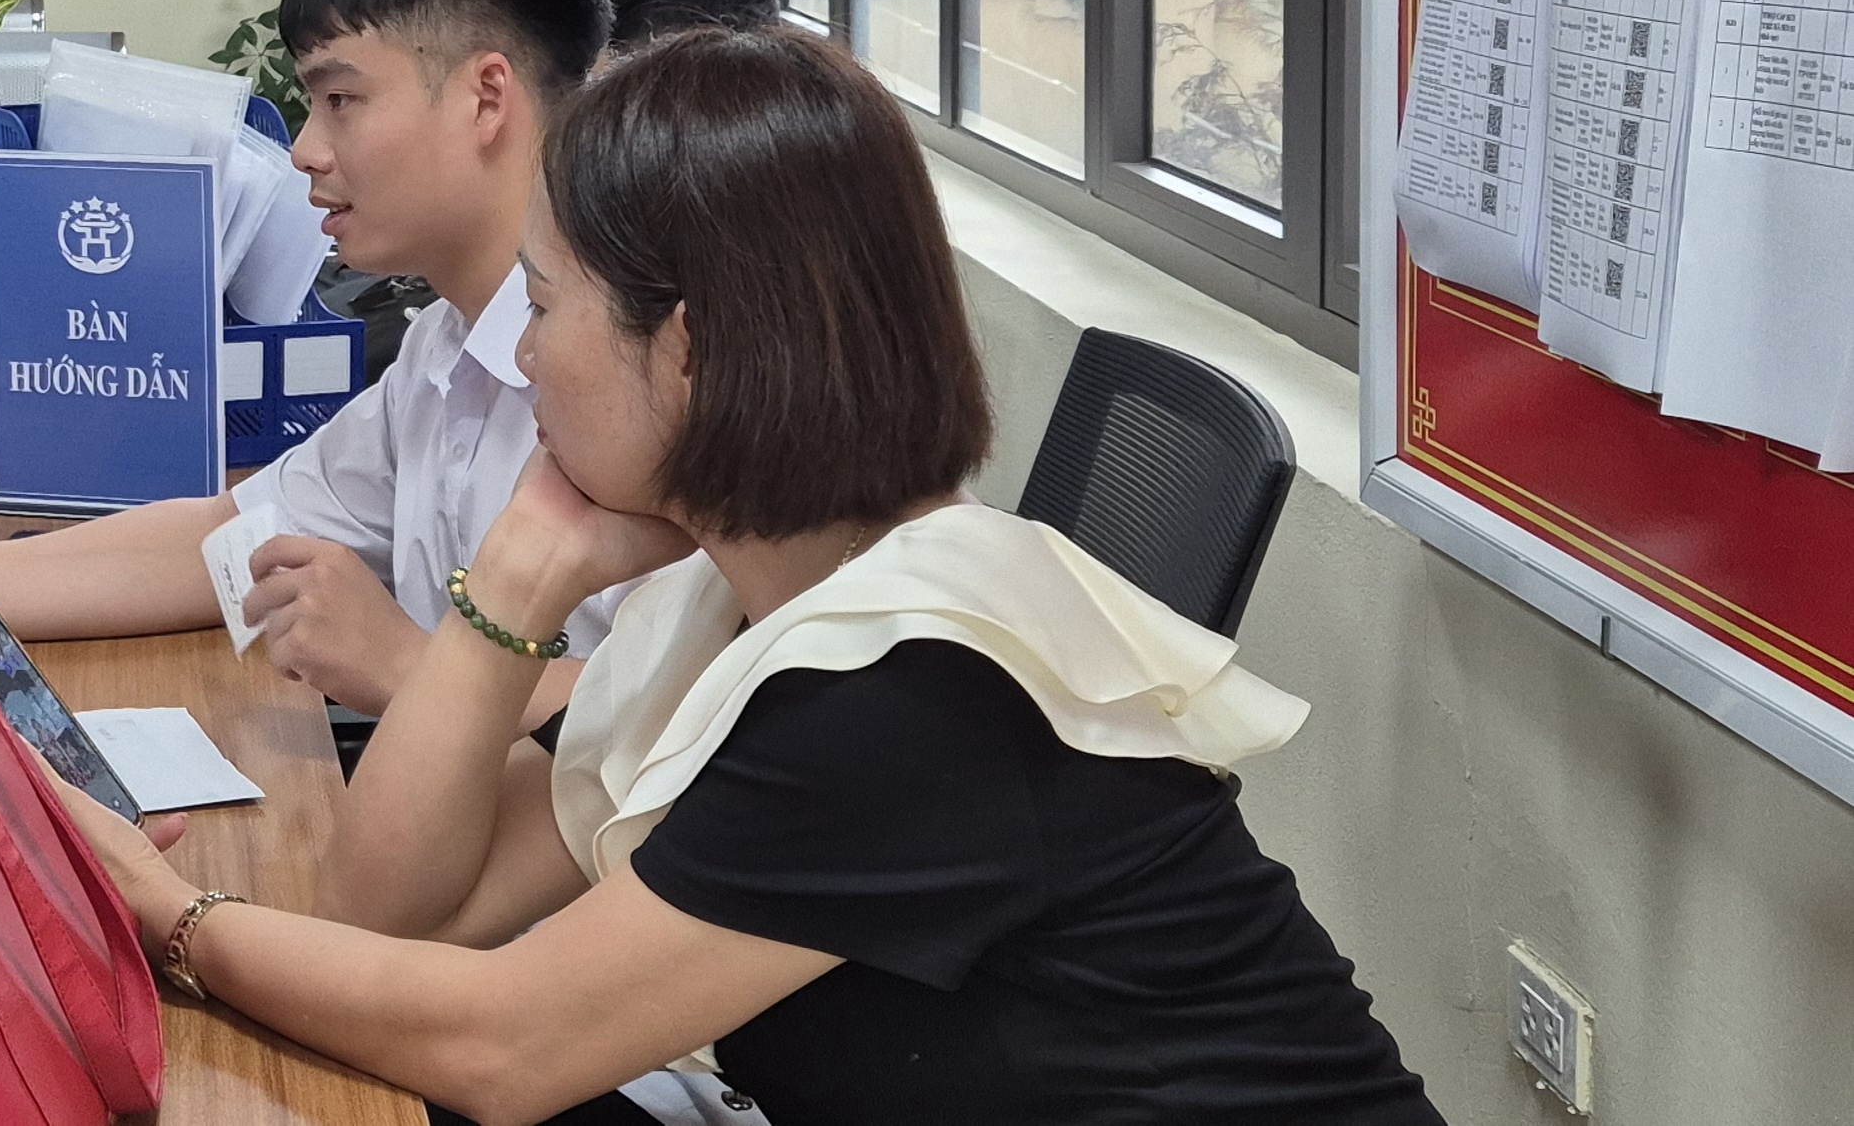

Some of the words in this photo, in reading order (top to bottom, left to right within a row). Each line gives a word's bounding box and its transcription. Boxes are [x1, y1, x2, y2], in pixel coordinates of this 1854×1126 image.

[66, 300, 129, 343] BÀN
[9, 354, 119, 397] HƯỚNG
[126, 352, 189, 401] DẪN
